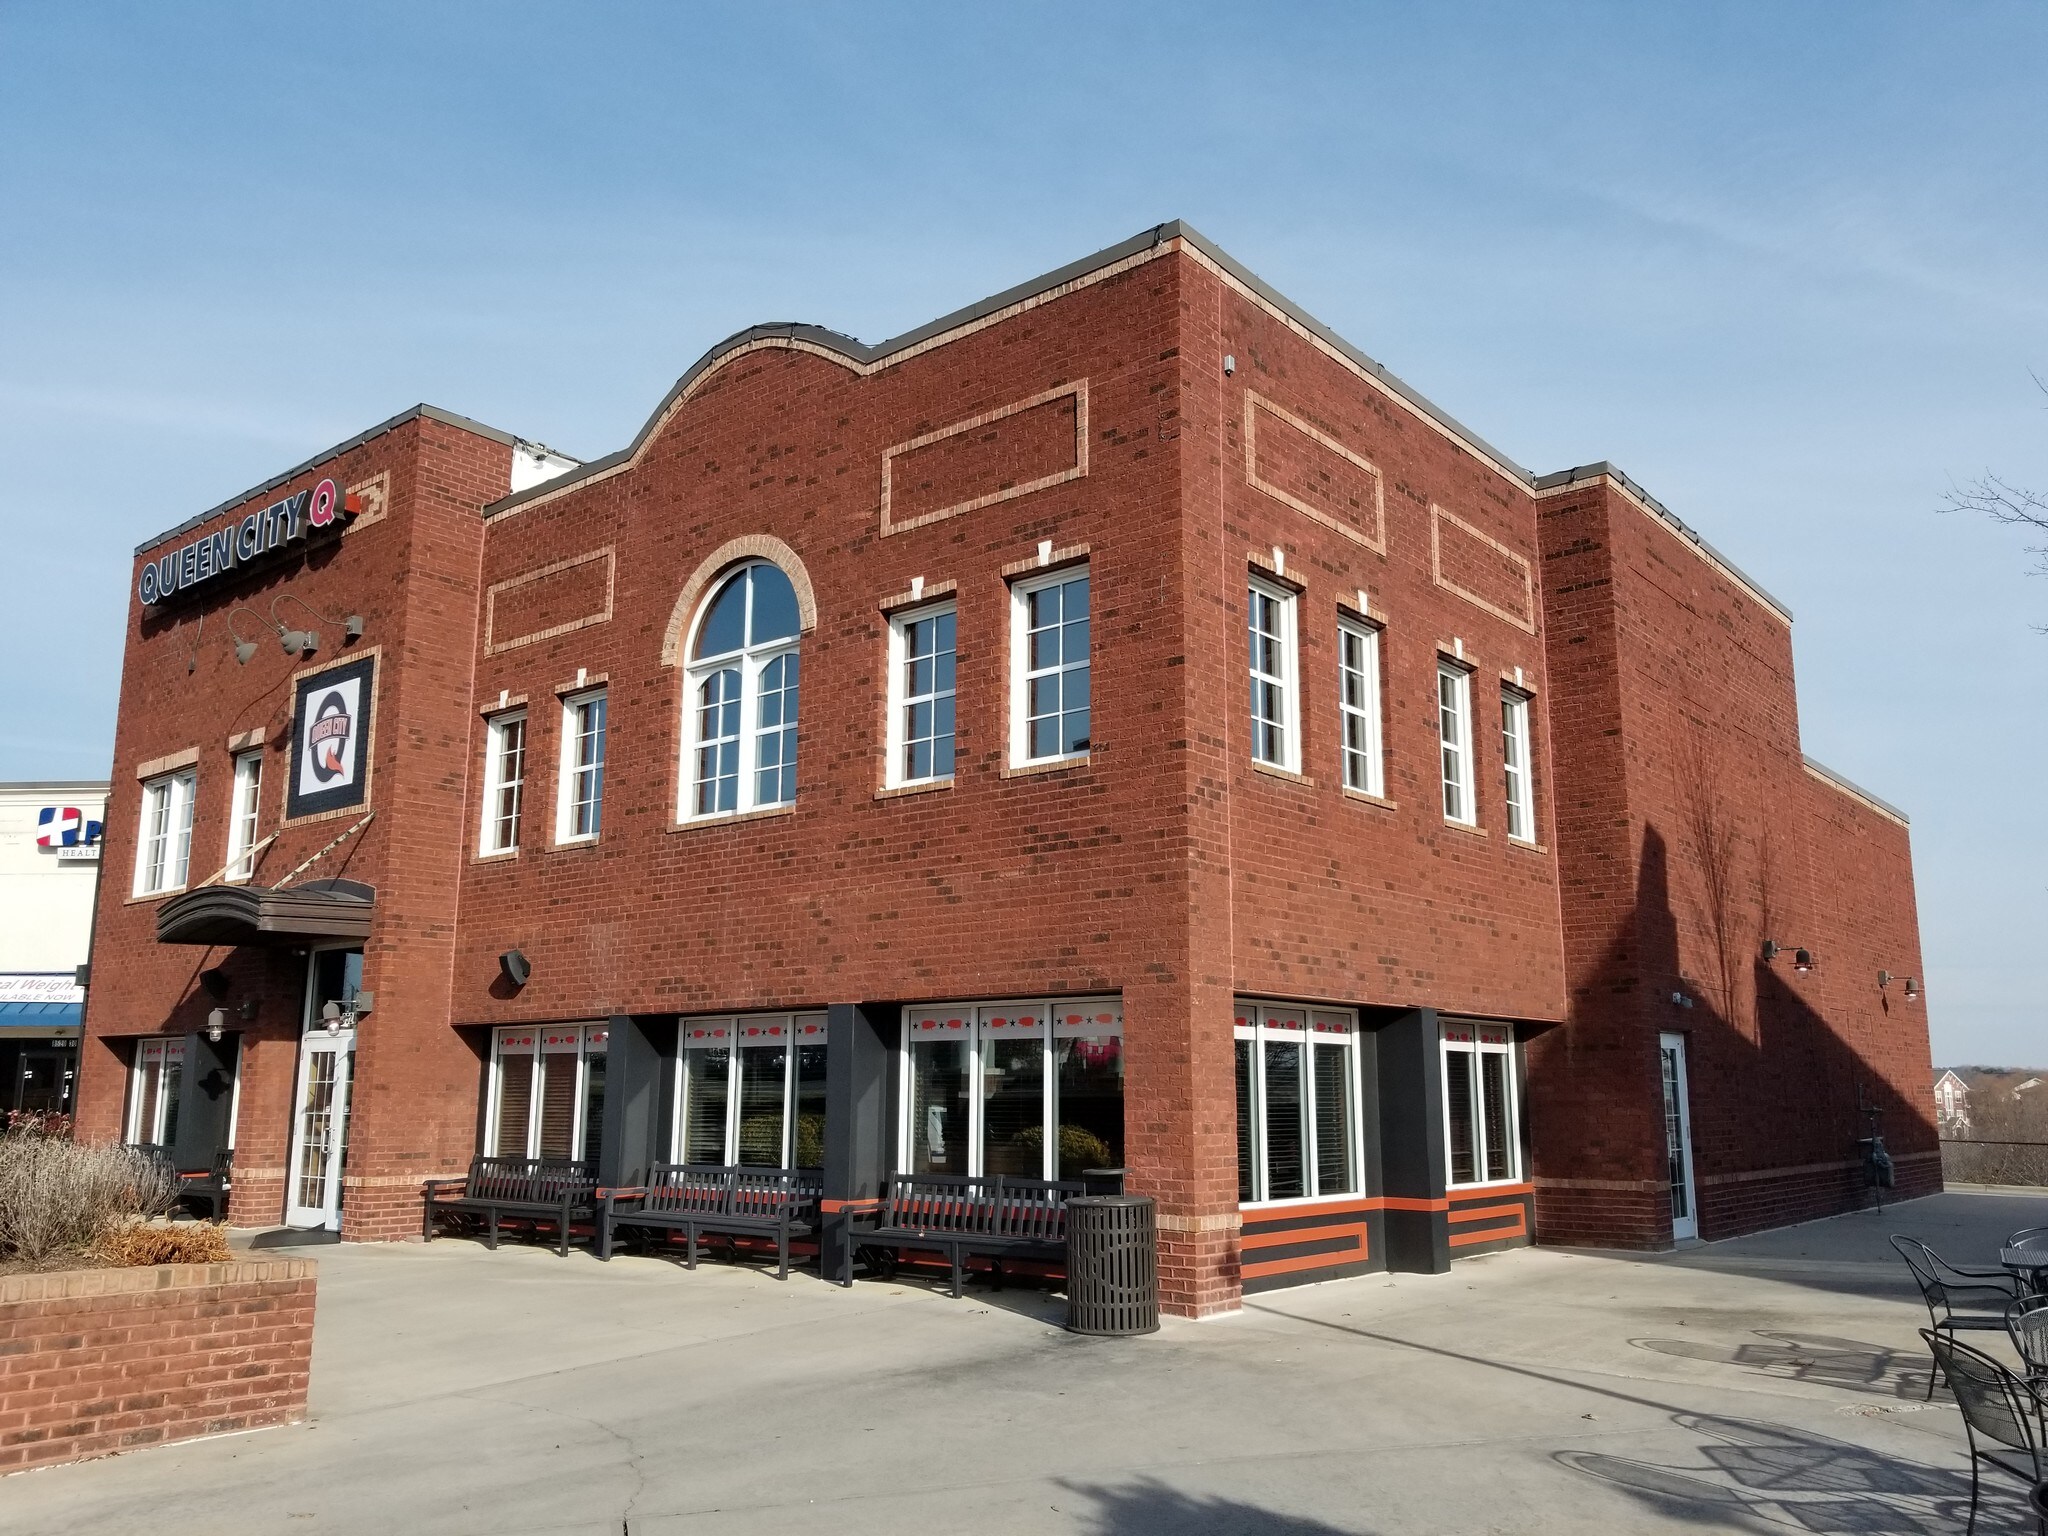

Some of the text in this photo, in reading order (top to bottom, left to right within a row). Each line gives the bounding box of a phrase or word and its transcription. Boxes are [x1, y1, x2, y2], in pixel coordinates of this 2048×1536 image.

[139, 478, 336, 605] QUEEN CITY Q
[311, 717, 348, 744] QUEEN CITY
[44, 993, 76, 1001] NOW
